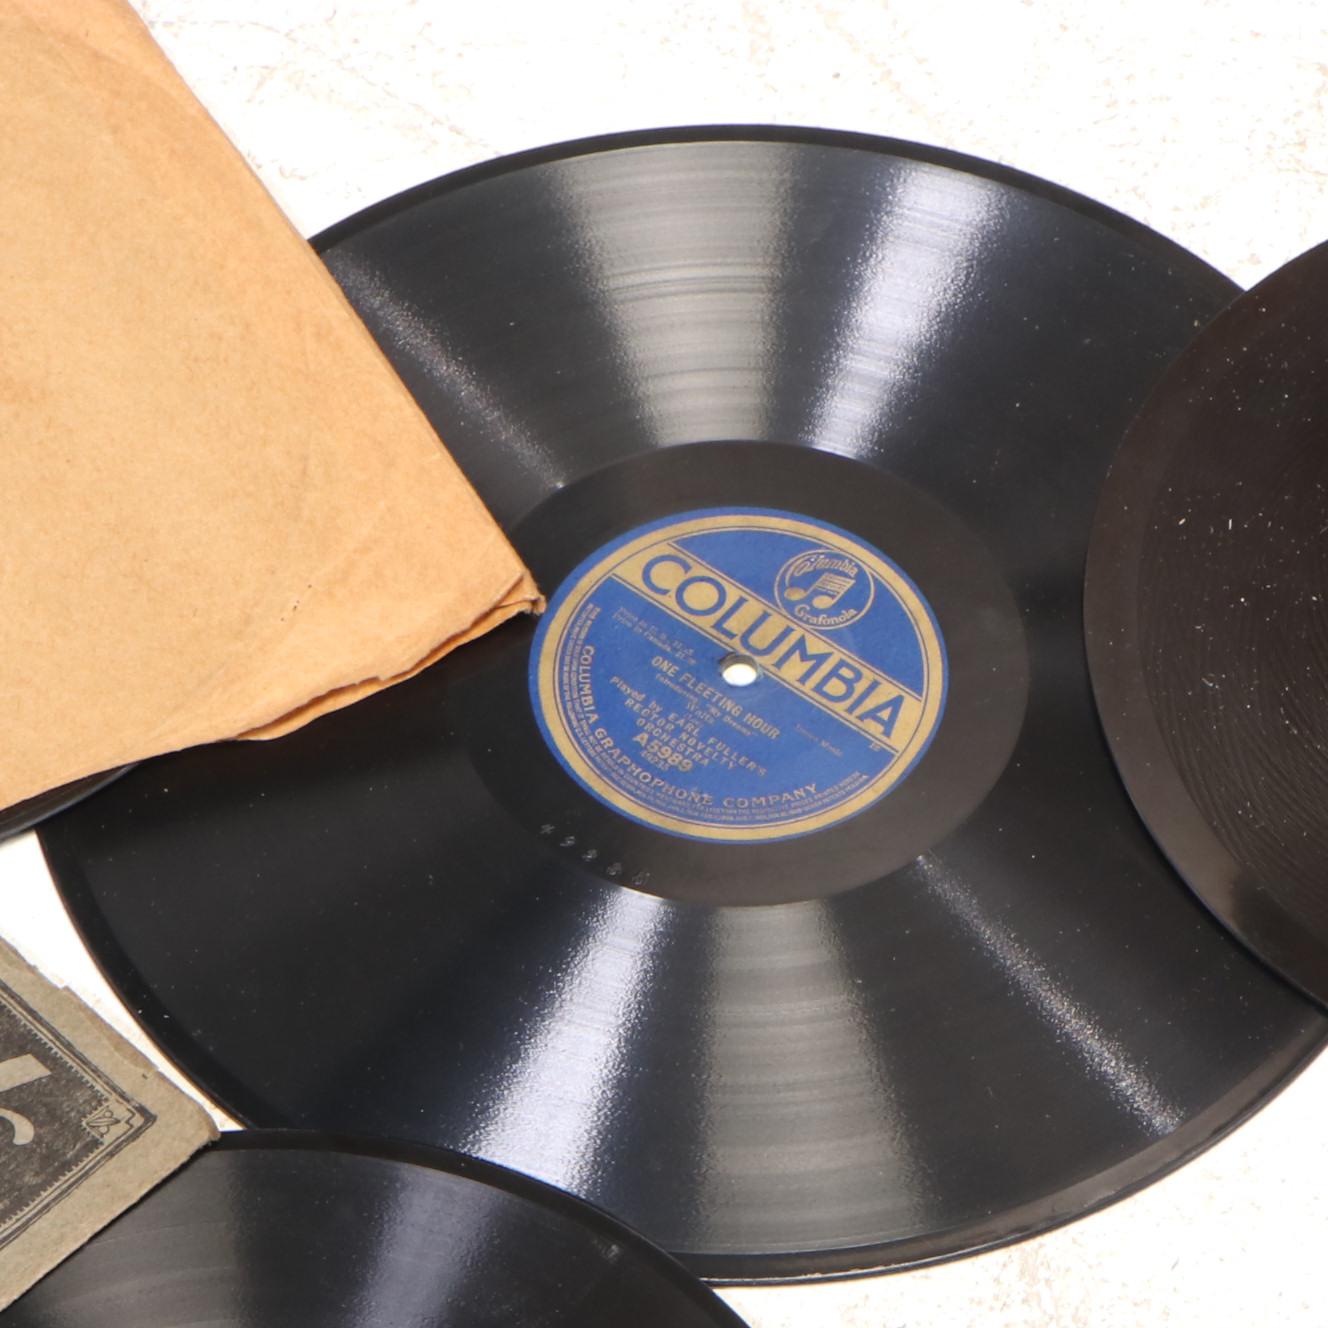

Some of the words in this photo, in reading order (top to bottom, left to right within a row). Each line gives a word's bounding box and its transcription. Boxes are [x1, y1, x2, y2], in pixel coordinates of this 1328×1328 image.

[794, 604, 858, 626] Grafonola
[642, 554, 906, 738] COLUMBIA
[609, 676, 646, 702] Played
[668, 712, 701, 737] EARL
[651, 655, 680, 678] ONE
[679, 672, 743, 717] FLEETING
[743, 712, 781, 740] HOUR
[578, 645, 600, 724] COLUMBIA
[594, 727, 713, 805] GRAPHOPHONE
[723, 783, 817, 809] COMPANY
[632, 732, 693, 772] A5989
[636, 718, 710, 767] ORCHESTRA
[680, 731, 736, 769] NOVELTY
